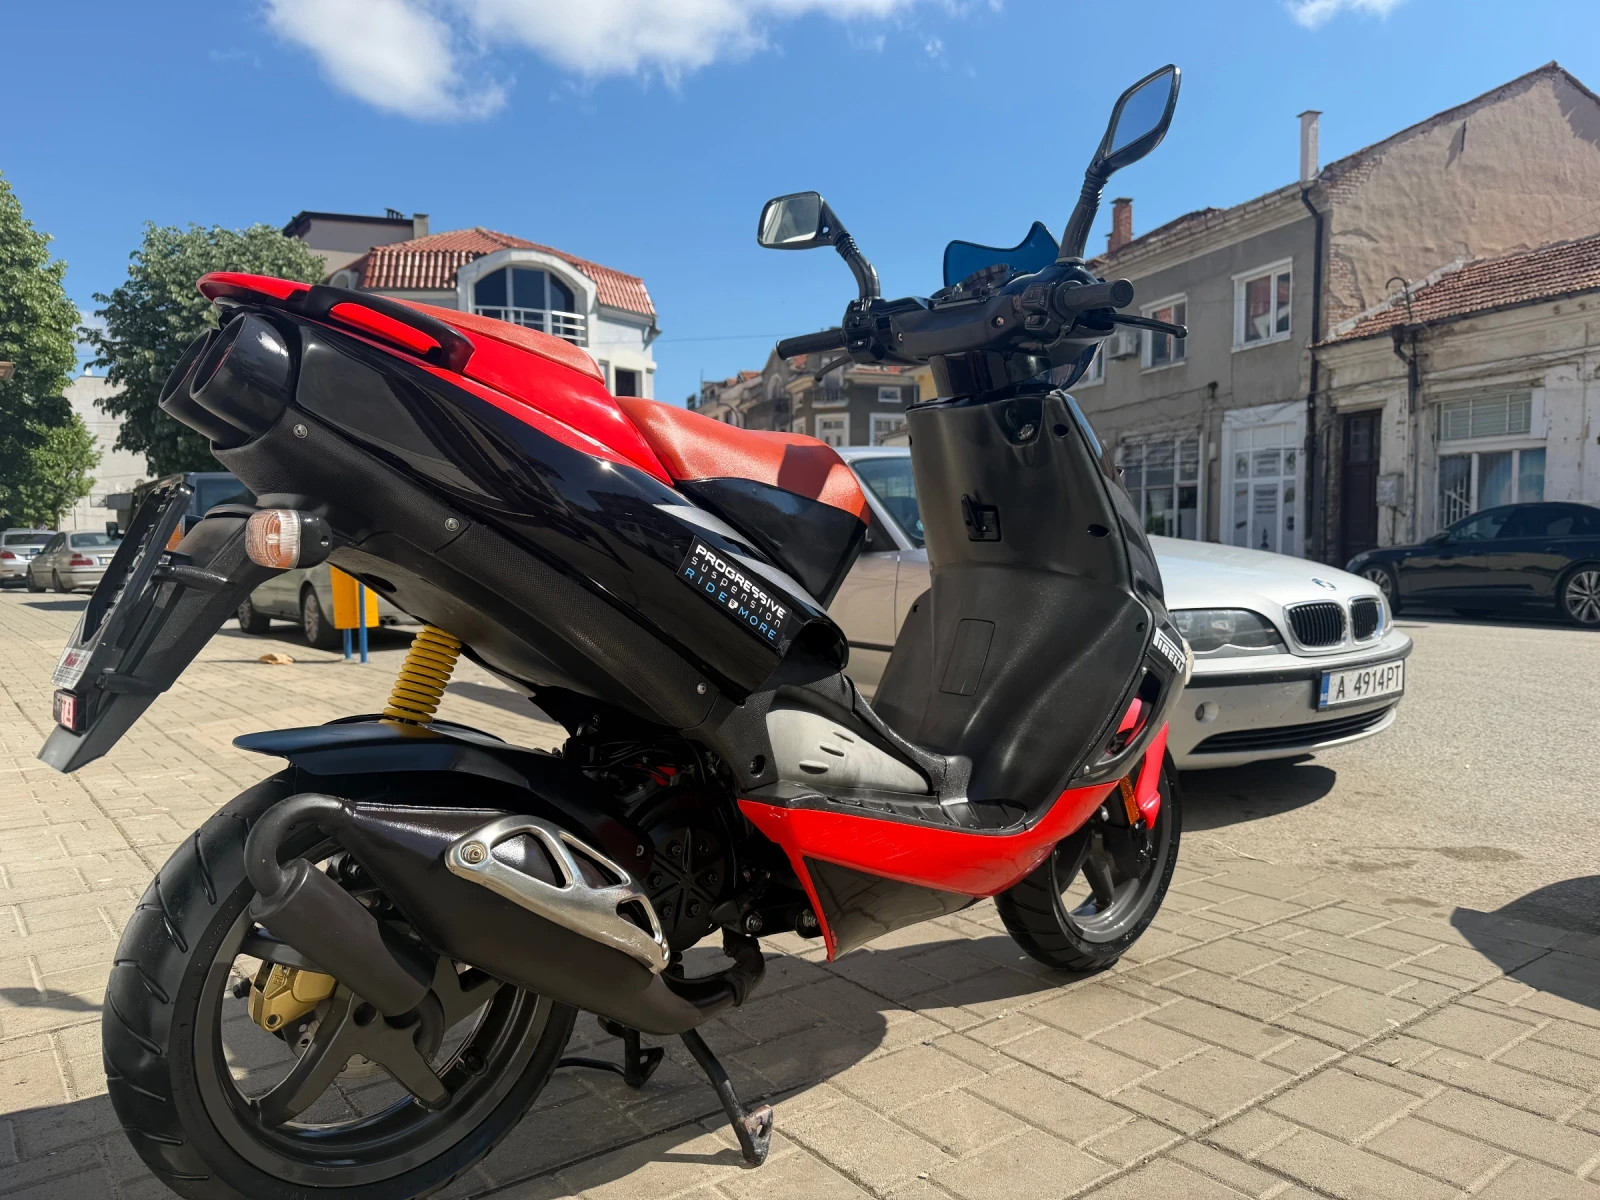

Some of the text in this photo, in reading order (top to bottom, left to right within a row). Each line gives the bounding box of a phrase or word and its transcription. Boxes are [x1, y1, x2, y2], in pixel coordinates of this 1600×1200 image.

[684, 567, 777, 640] RIDE MORE
[691, 556, 781, 628] suspension
[695, 544, 786, 619] PROGRESSIVE
[1152, 626, 1186, 674] PIRELLI
